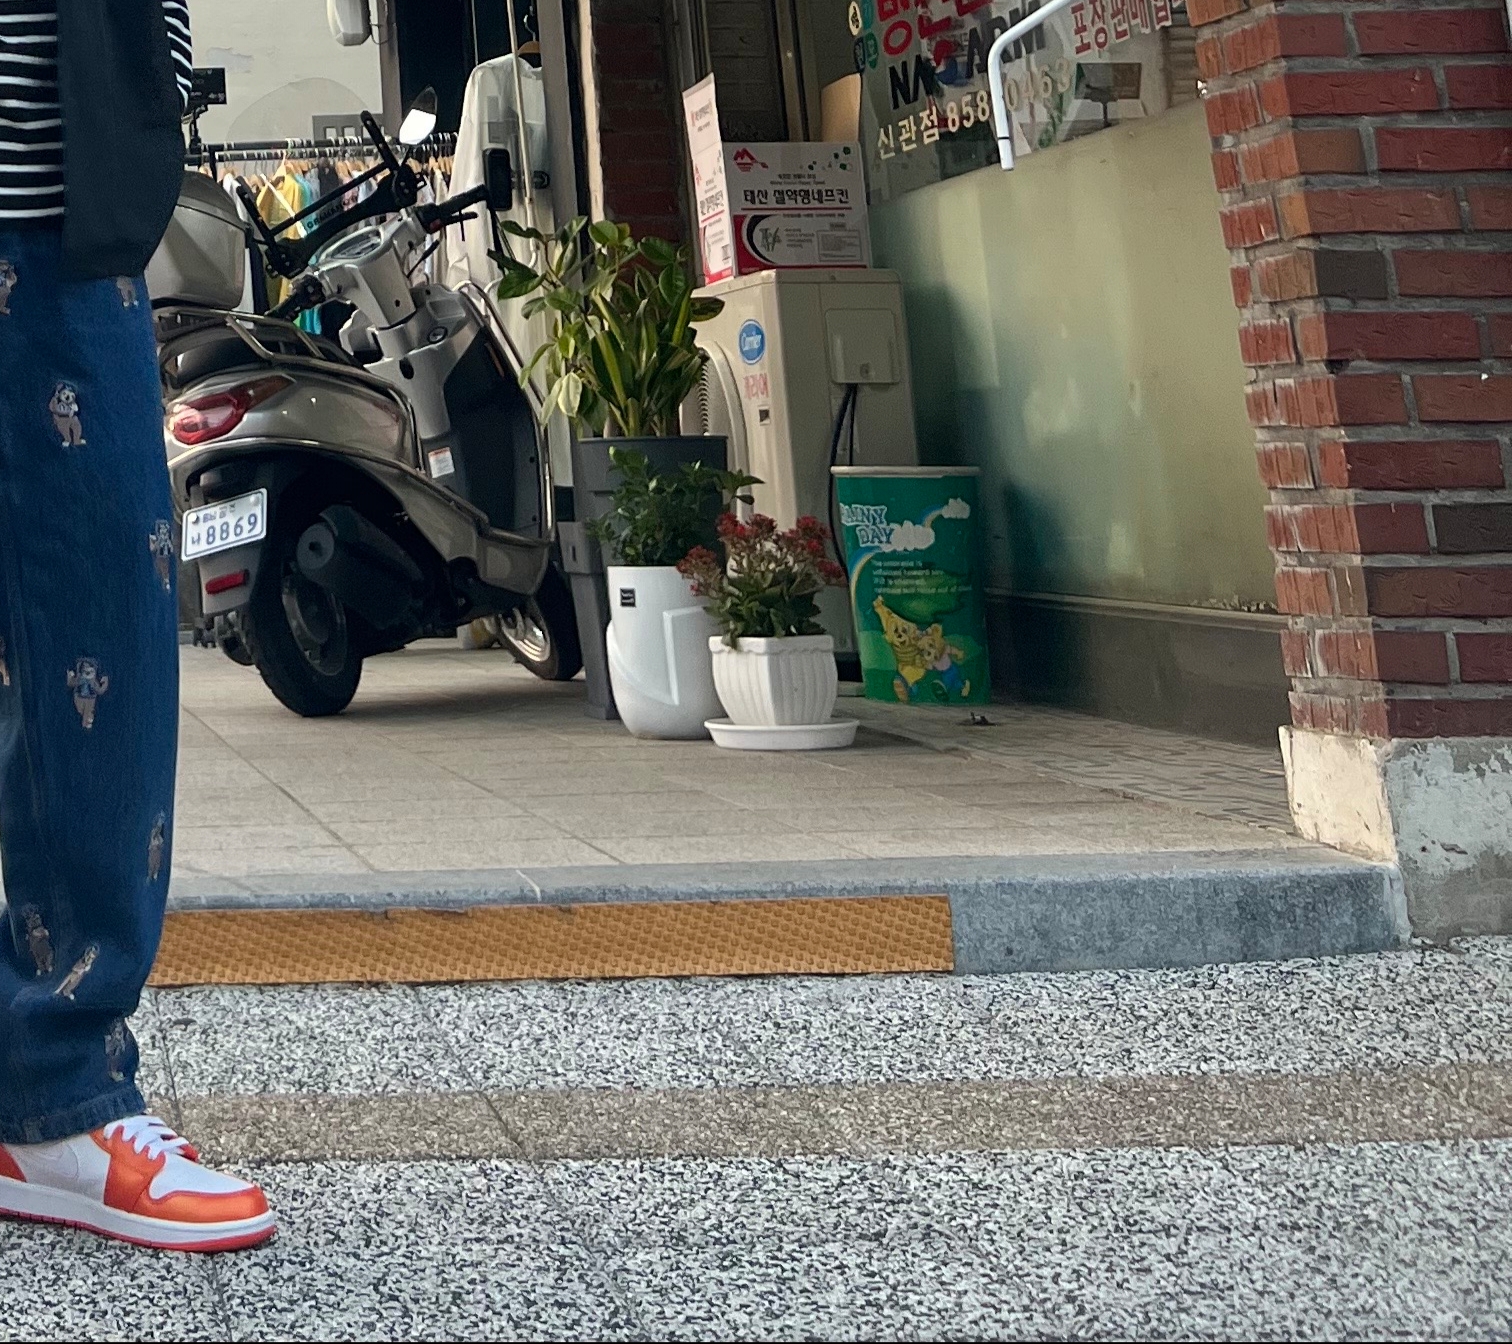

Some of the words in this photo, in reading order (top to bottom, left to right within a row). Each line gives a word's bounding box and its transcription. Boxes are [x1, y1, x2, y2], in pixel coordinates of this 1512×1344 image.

[877, 106, 940, 160] 신관점
[206, 513, 258, 545] 8869
[857, 526, 894, 545] DAY
